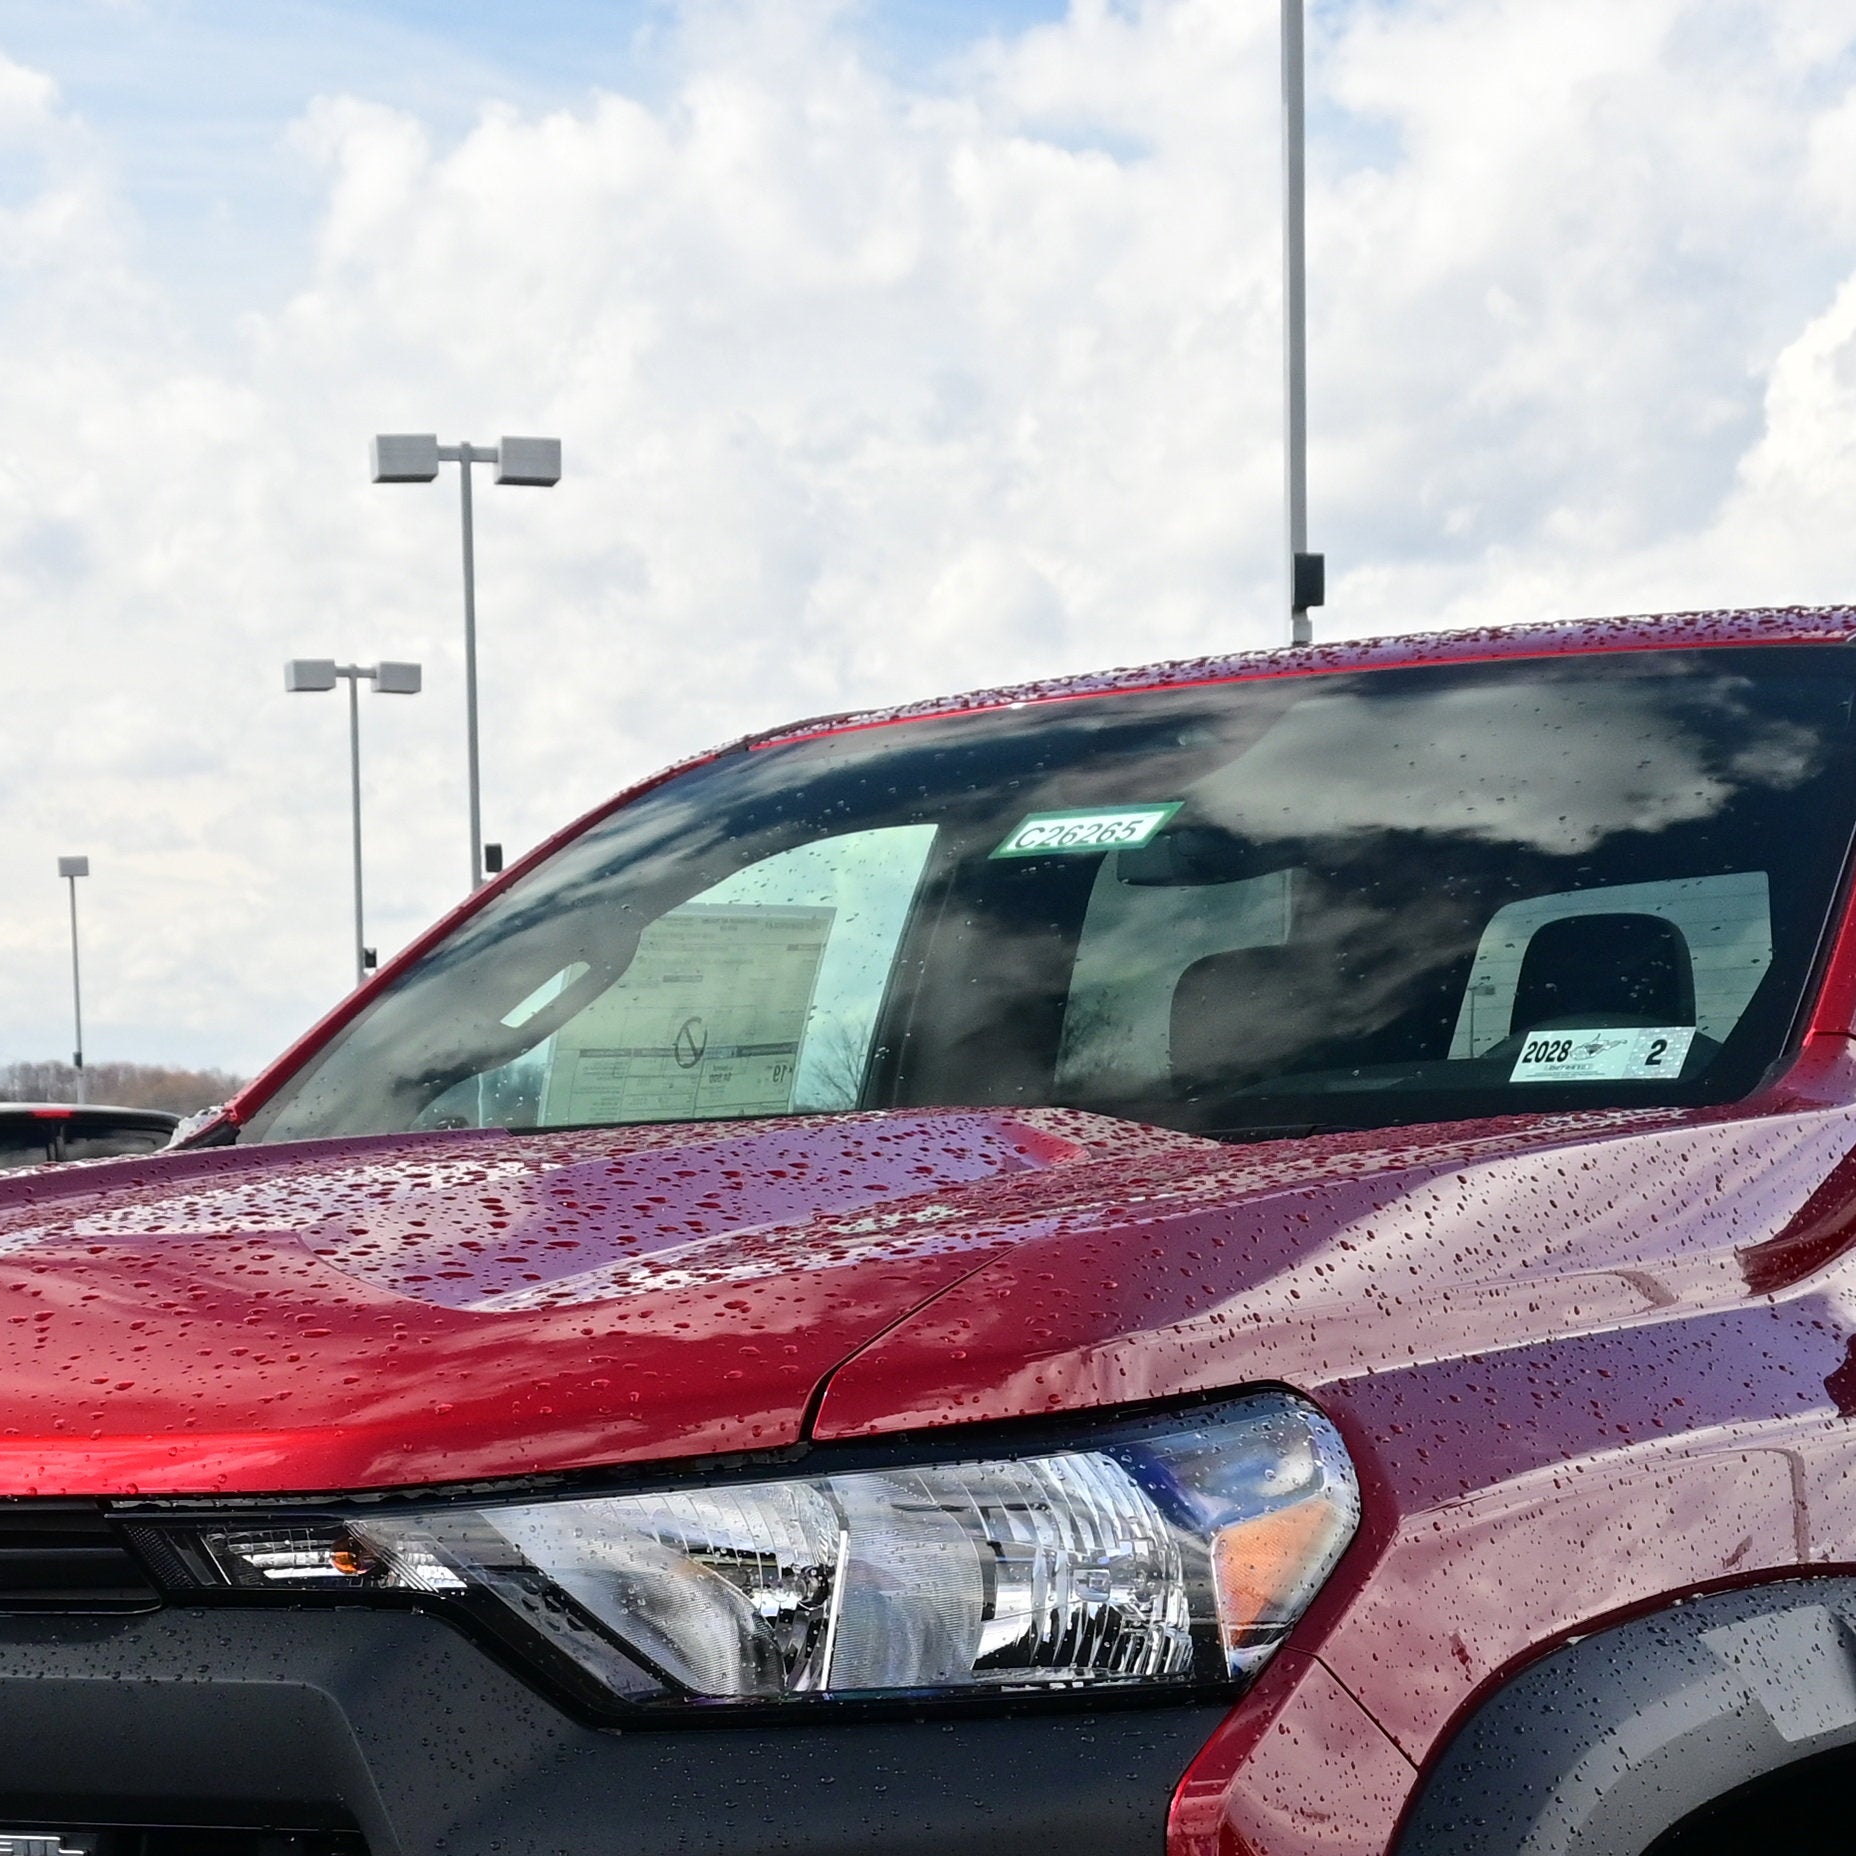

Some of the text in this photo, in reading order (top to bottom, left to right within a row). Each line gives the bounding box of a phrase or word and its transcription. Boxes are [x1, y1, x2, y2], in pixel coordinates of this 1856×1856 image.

[1015, 819, 1144, 849] C26265
[1522, 1039, 1667, 1065] 2028 2
